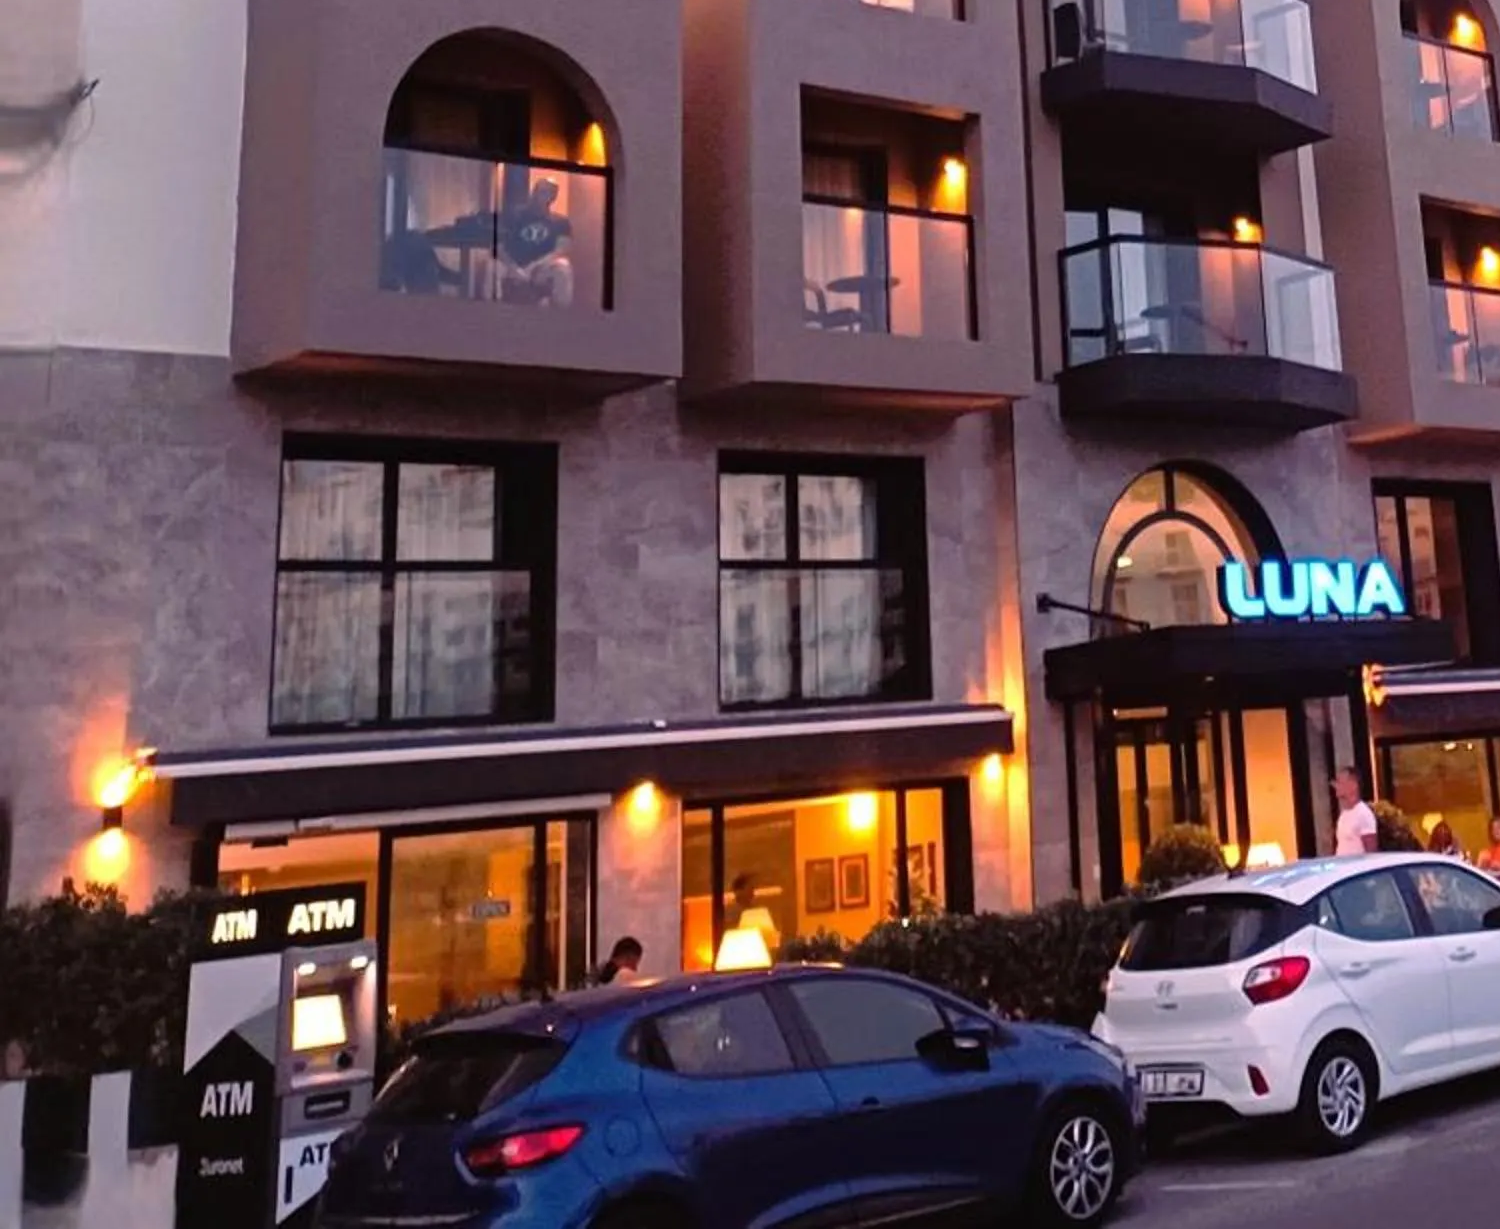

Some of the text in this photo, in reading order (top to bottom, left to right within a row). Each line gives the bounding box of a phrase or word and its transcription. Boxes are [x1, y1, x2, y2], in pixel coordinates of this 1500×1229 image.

[1225, 561, 1405, 617] LUNA
[211, 909, 258, 944] ATM
[287, 898, 355, 935] ATM
[200, 1080, 254, 1118] ATM
[300, 1143, 328, 1167] AT
